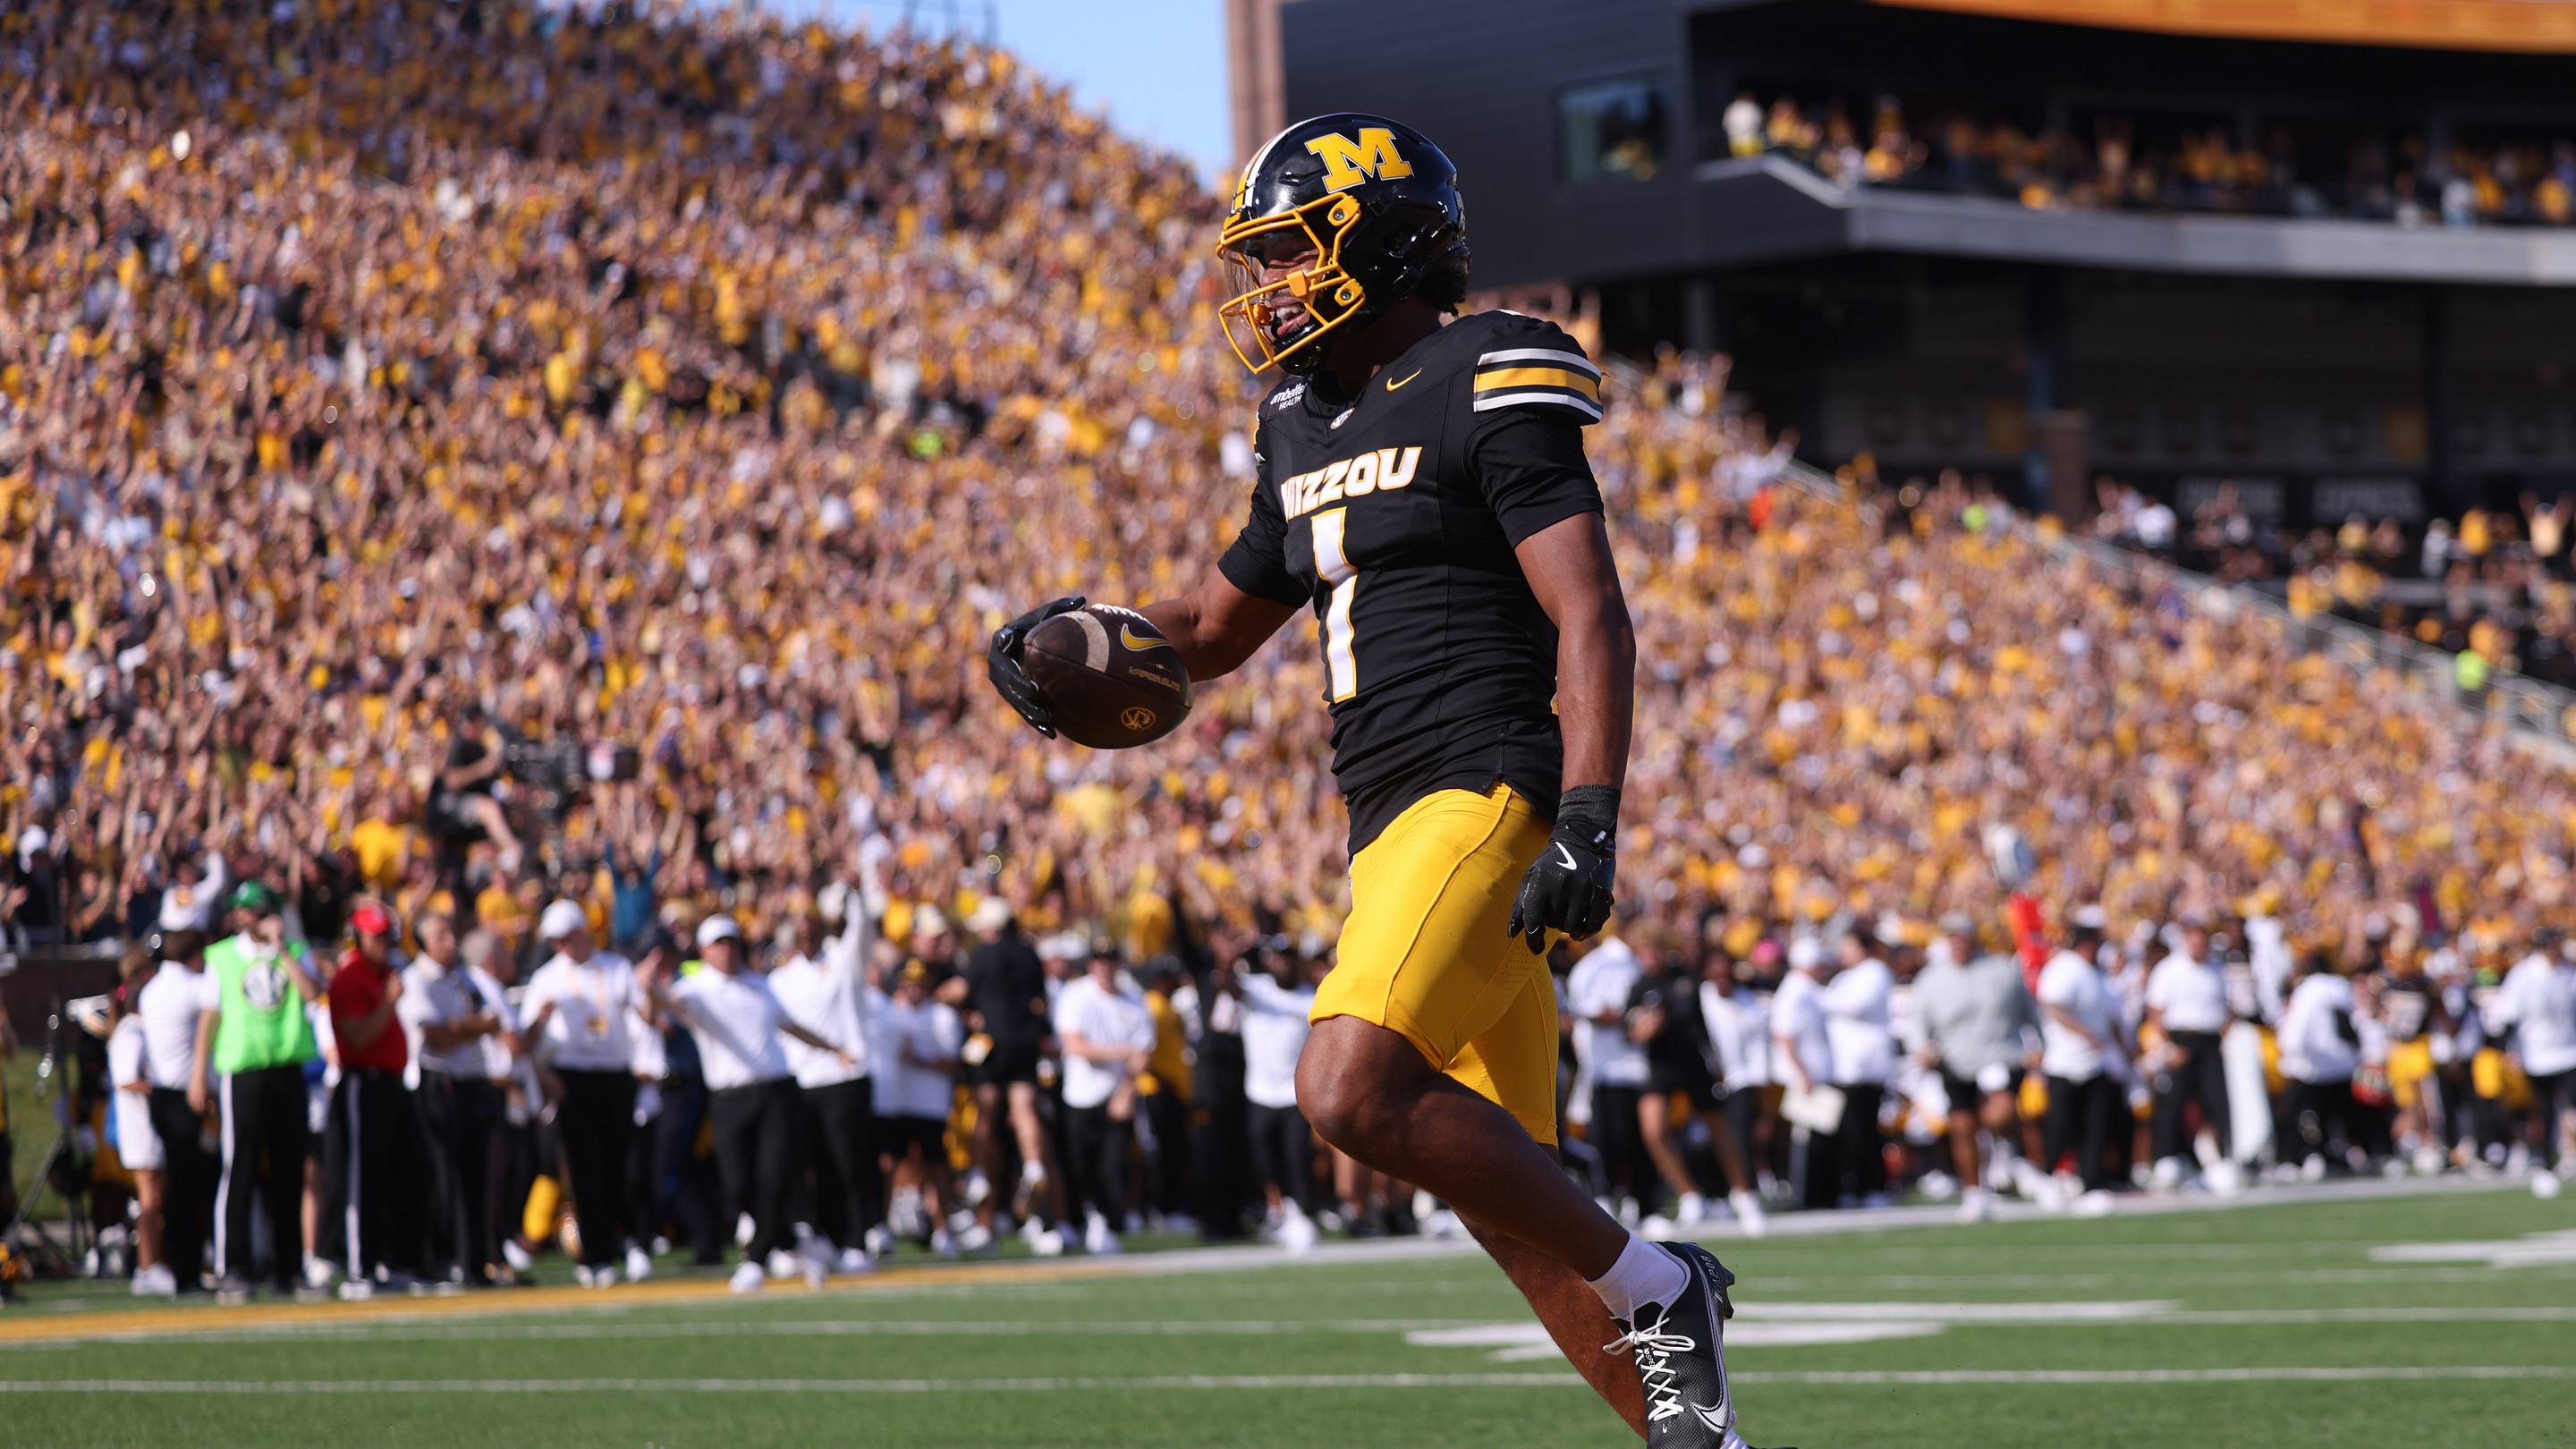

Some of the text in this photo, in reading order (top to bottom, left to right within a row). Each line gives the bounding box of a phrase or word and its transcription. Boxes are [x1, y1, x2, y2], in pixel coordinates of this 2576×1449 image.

[1304, 128, 1414, 194] M
[1279, 394, 1302, 411] HEALTH
[1310, 506, 1358, 704] 1
